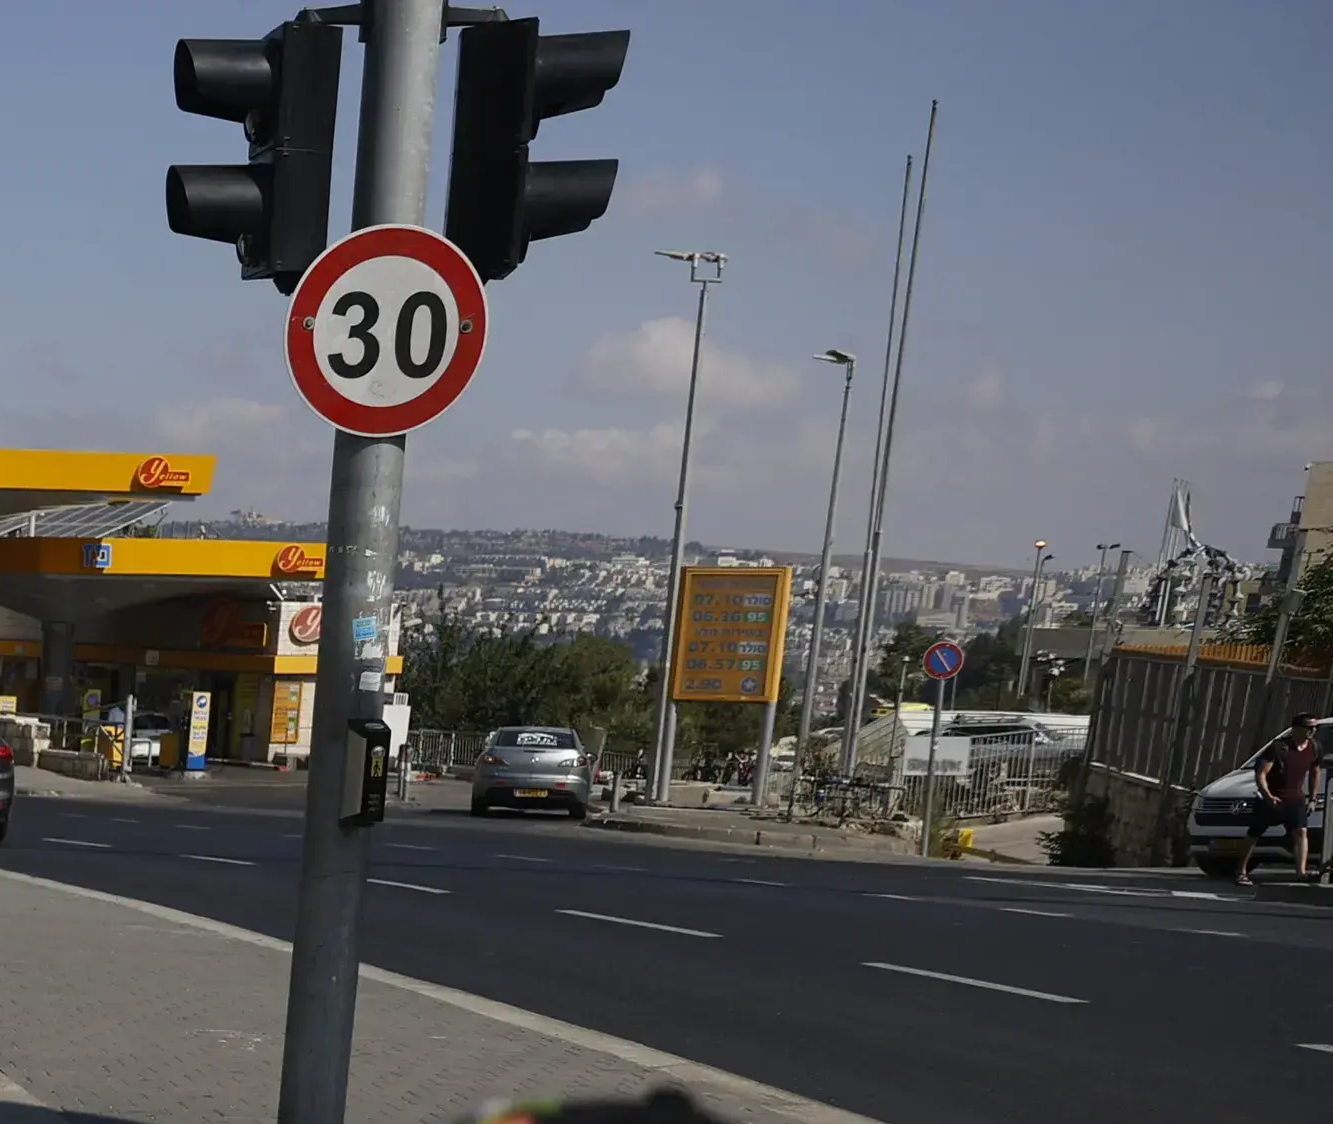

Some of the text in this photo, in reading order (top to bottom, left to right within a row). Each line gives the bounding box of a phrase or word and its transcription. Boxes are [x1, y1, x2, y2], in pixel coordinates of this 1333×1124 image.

[327, 291, 447, 379] 30
[140, 458, 189, 485] Yellow
[83, 544, 111, 568] פז
[281, 546, 322, 571] Yellow
